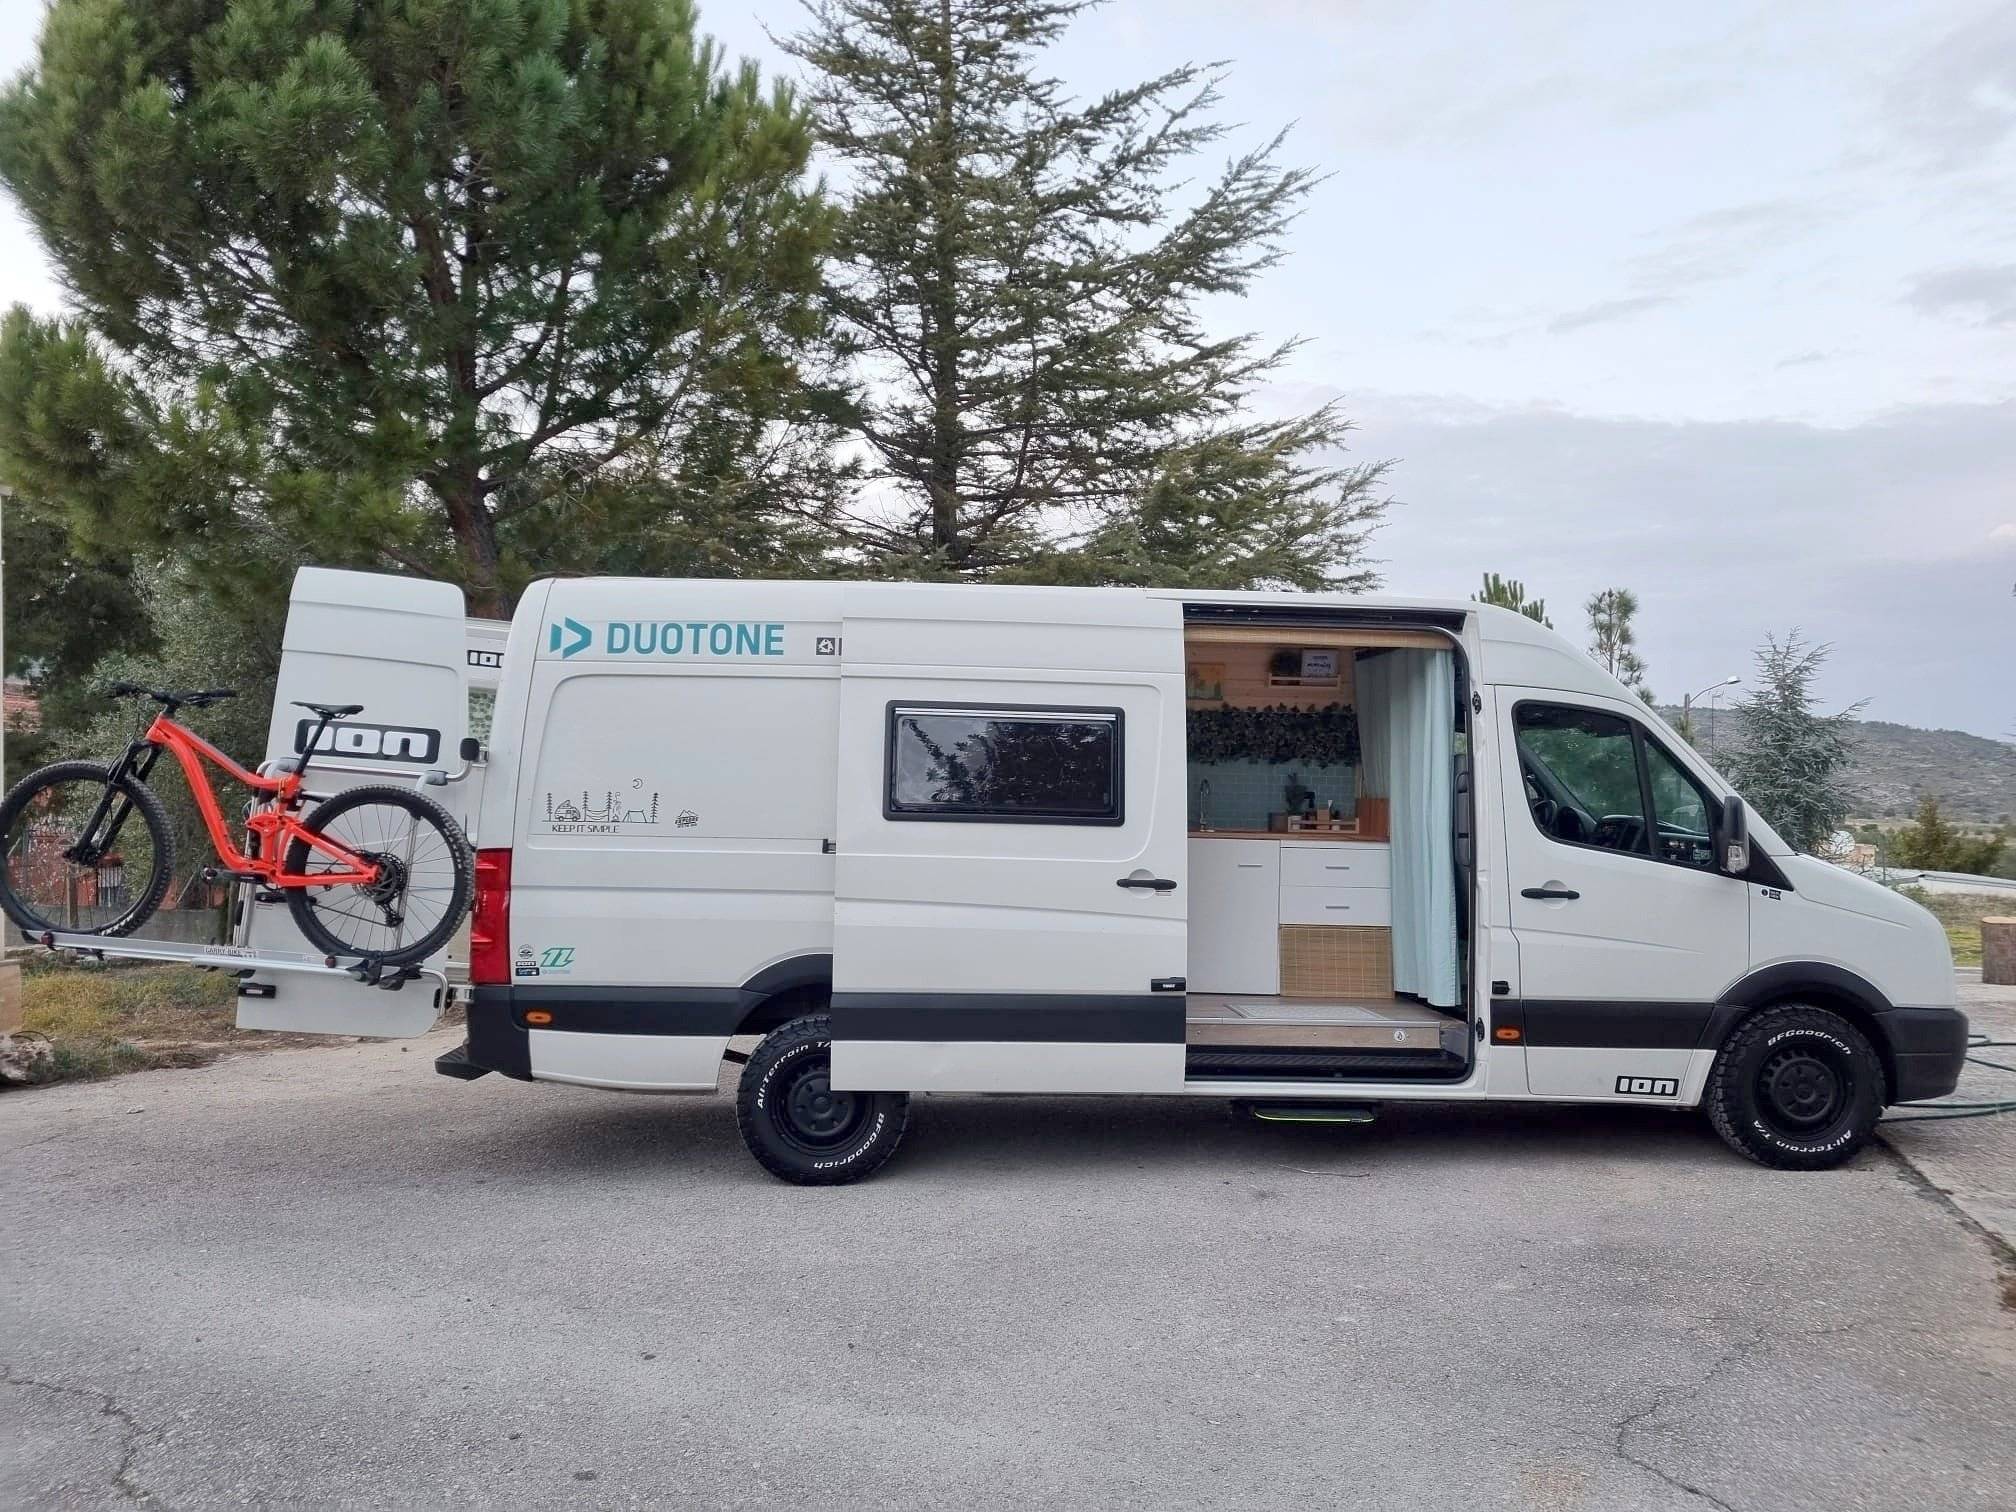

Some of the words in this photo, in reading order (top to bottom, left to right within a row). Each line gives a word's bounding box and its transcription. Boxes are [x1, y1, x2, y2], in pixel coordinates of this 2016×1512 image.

[606, 622, 785, 656] DUOTONE
[551, 824, 575, 833] KEEP
[587, 825, 619, 834] SIMPLE
[1766, 1029, 1853, 1055] BFGoodrich
[757, 1043, 809, 1109] All-Terrain
[815, 1040, 831, 1048] T/
[814, 1111, 886, 1169] BFGoodrich
[1752, 1119, 1771, 1139] T/A
[1775, 1129, 1852, 1153] All-Terrain
